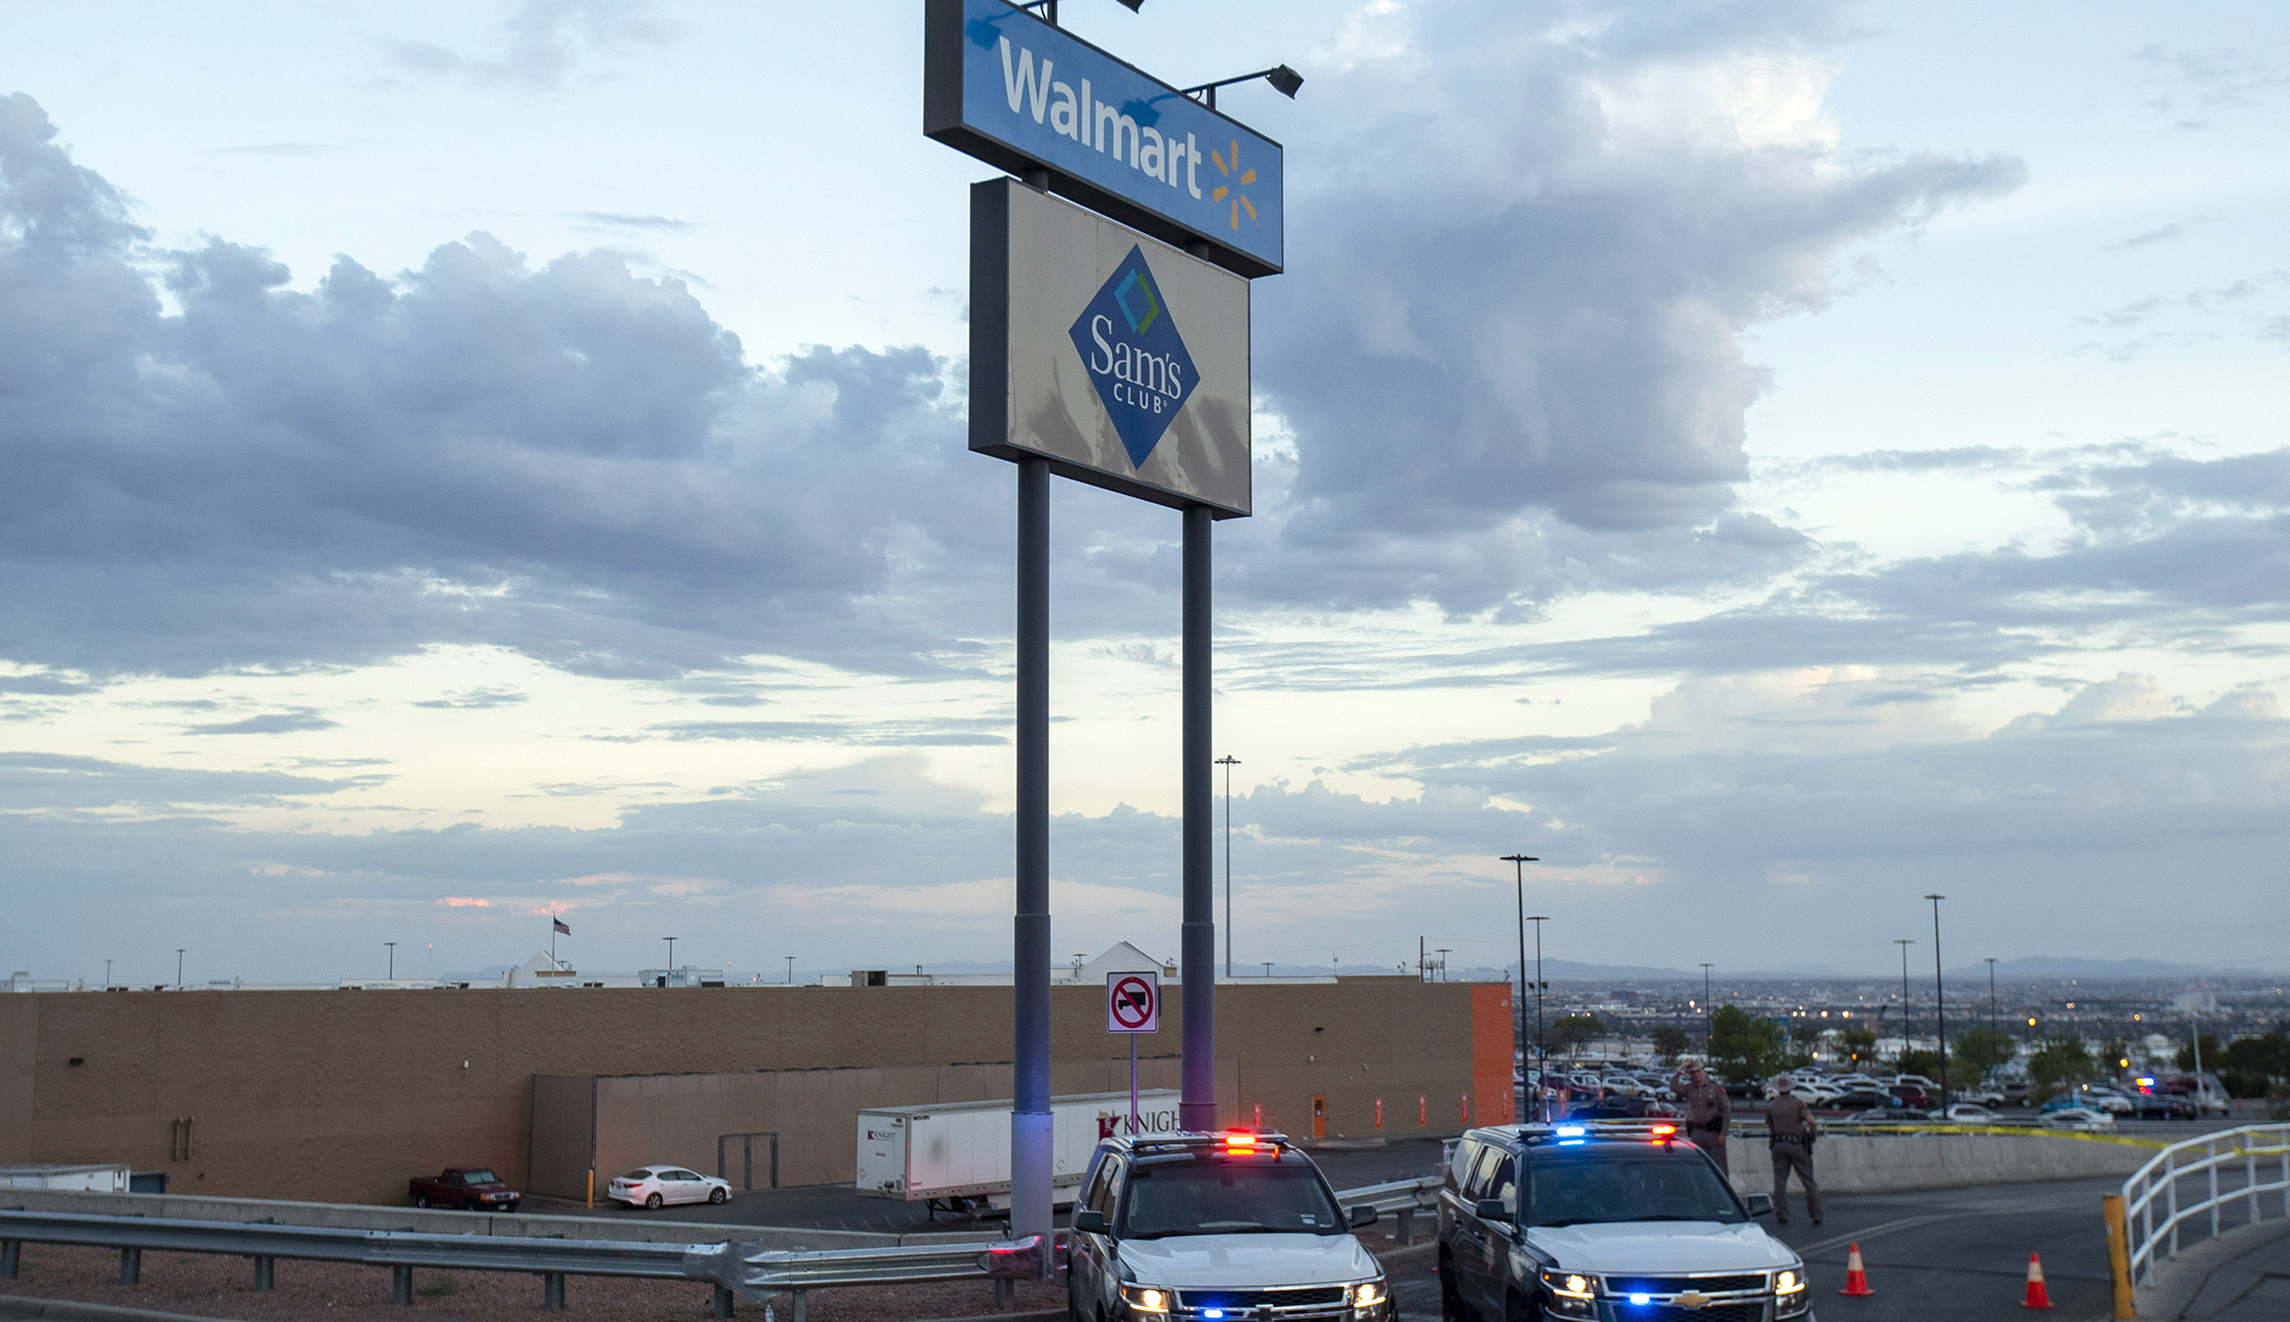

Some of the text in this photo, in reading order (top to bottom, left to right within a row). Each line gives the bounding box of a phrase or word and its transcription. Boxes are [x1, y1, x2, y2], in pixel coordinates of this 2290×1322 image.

[999, 36, 1202, 200] Walmart
[1091, 314, 1182, 400] Sam's
[1123, 1110, 1179, 1135] KNIGH
